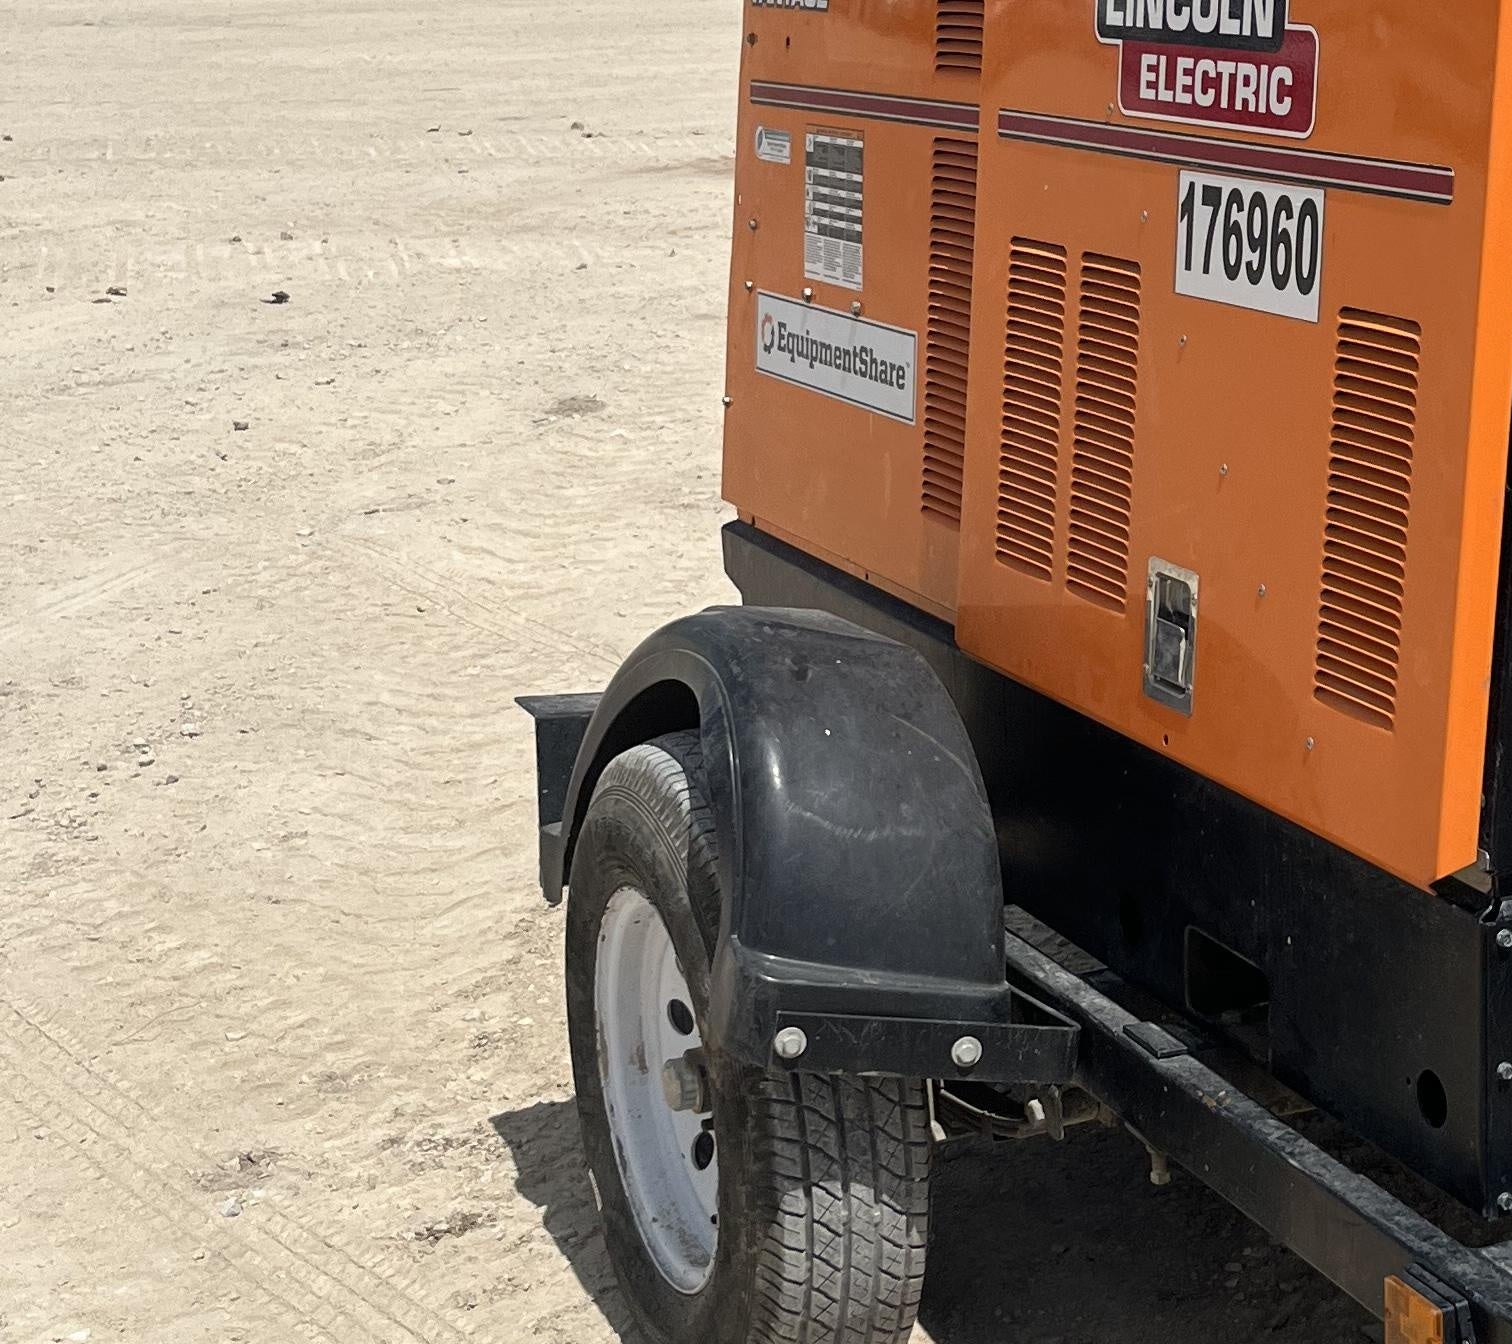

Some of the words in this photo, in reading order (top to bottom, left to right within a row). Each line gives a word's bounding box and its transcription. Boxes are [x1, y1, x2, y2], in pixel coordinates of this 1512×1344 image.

[1139, 54, 1293, 116] ELECTRIC
[1180, 181, 1319, 295] 176960
[777, 321, 906, 390] EquipmentShare
